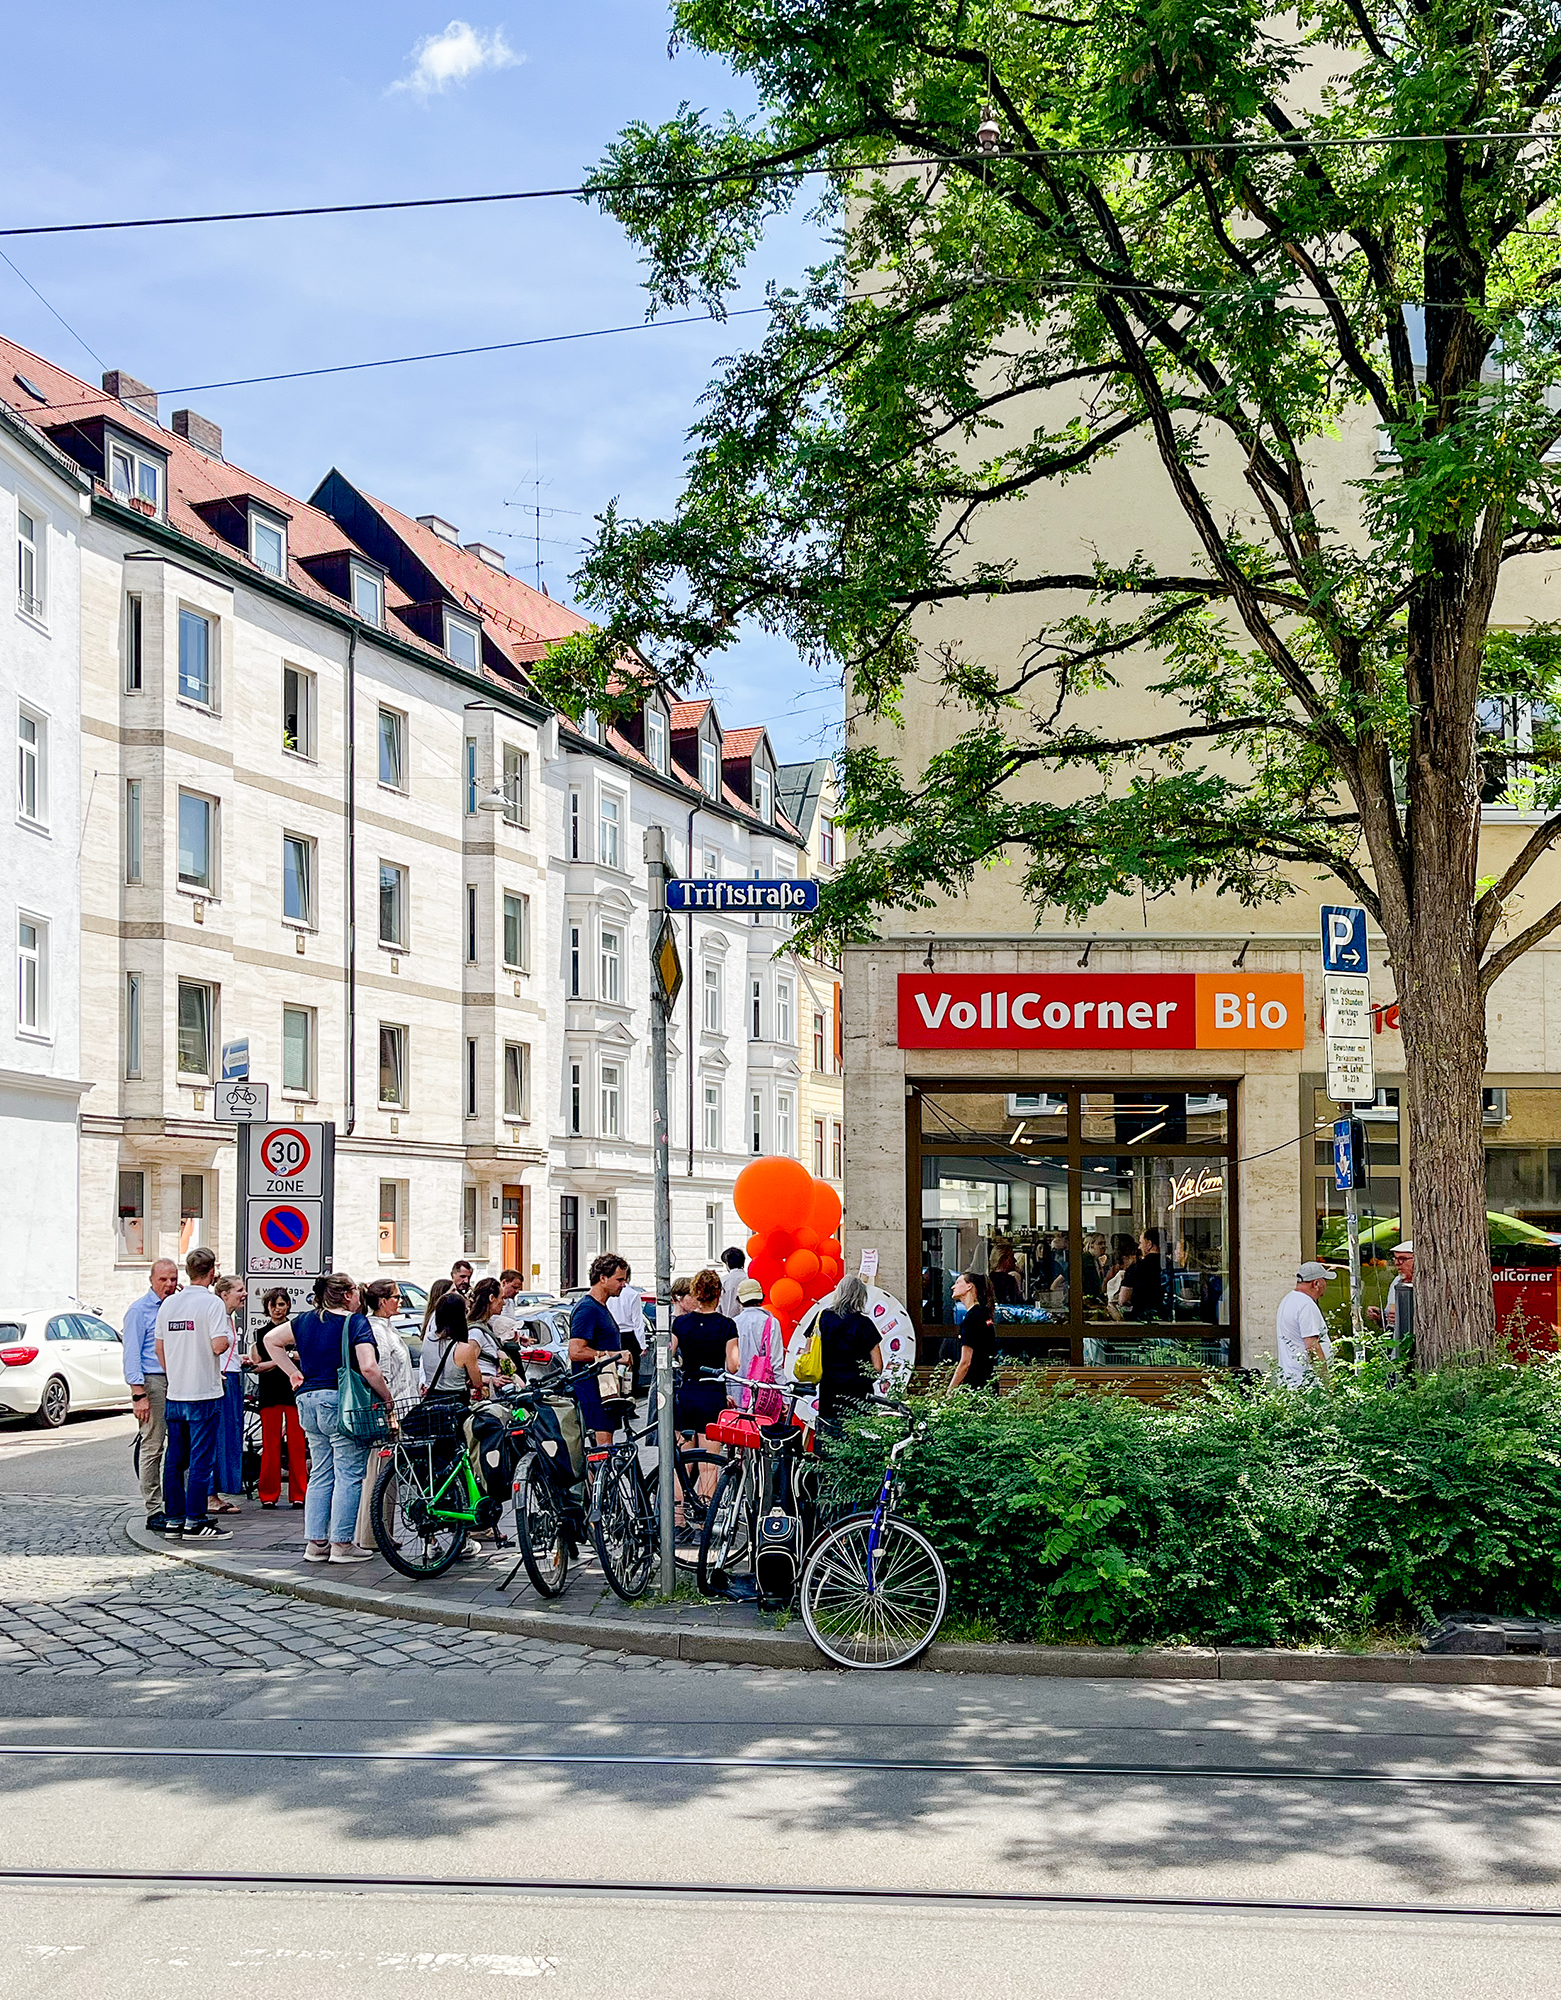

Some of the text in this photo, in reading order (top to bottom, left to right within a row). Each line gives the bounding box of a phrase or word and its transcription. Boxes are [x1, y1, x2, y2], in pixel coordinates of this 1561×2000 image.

[679, 882, 806, 909] Triftstraße
[1328, 914, 1354, 964] P
[914, 991, 1288, 1029] VollCorner Bio
[271, 1141, 300, 1164] 30
[266, 1180, 304, 1192] ZONE
[1491, 1271, 1553, 1282] ollCorner
